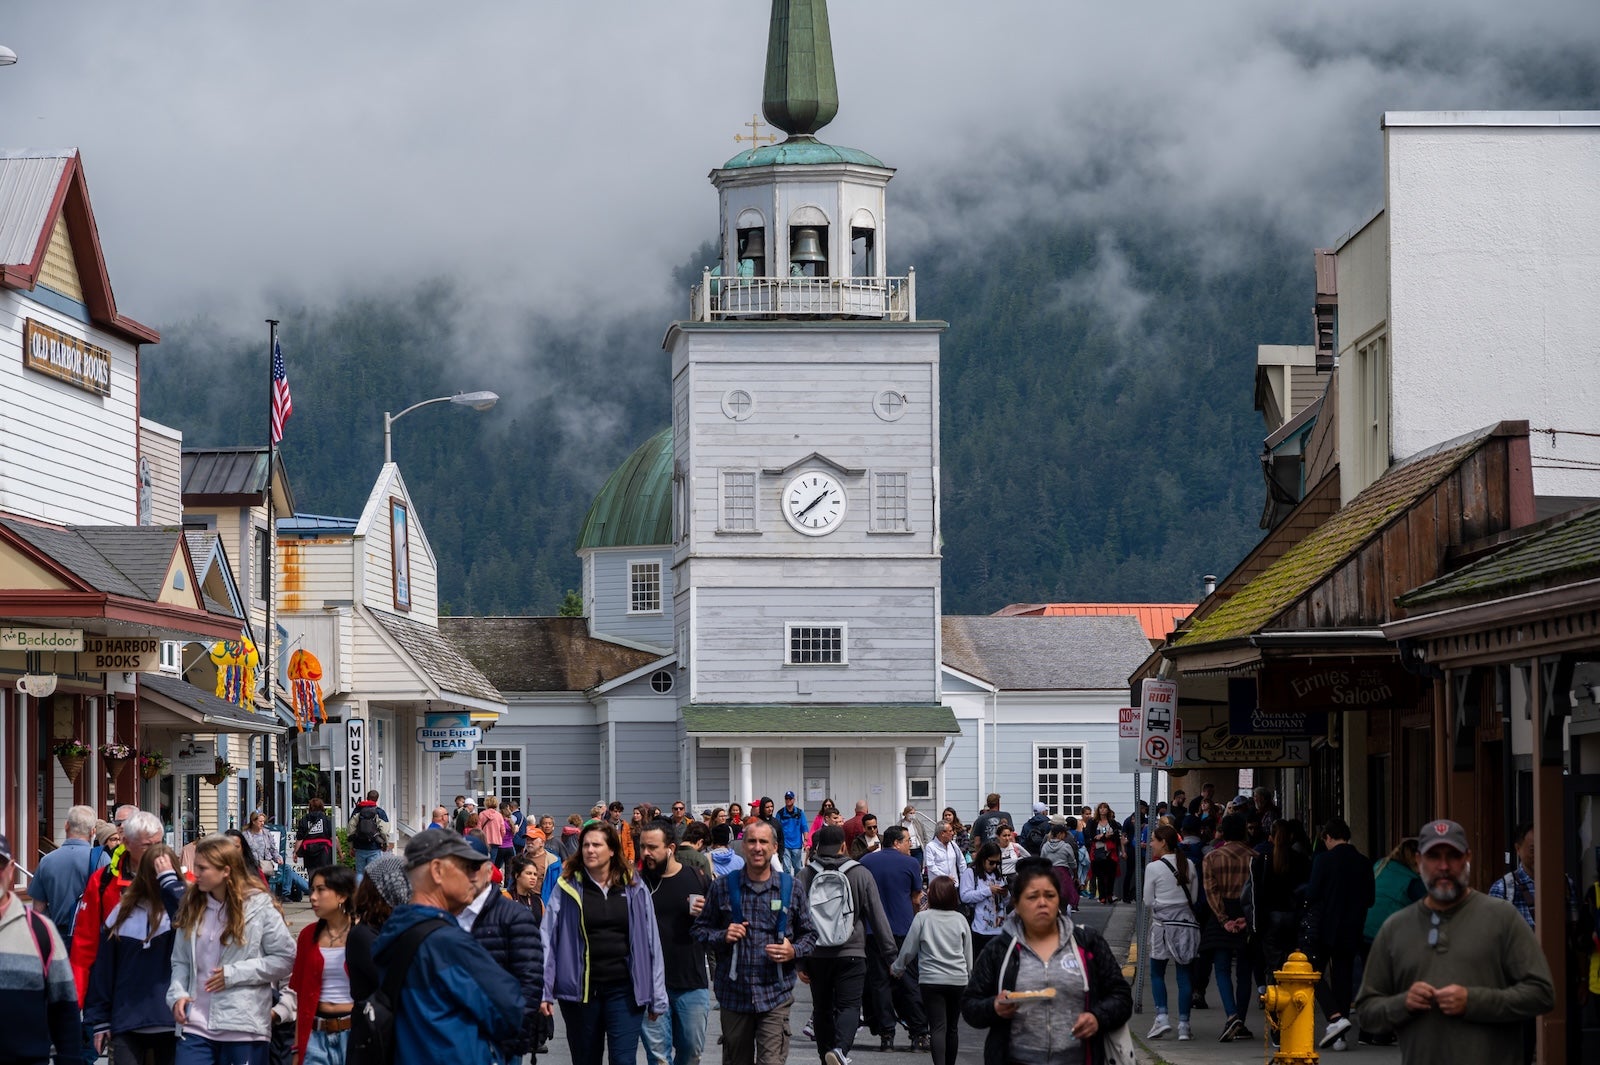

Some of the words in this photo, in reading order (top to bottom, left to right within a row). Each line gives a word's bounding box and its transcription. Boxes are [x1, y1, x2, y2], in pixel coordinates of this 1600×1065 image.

[32, 331, 48, 360] OLD
[50, 338, 82, 375] HARBOR
[83, 352, 109, 385] BOOKS
[2, 632, 17, 643] The
[18, 632, 79, 646] Backdoor
[106, 640, 157, 653] HARBOR
[96, 655, 141, 668] BOOKS
[1290, 670, 1350, 699] Ernies
[1149, 693, 1172, 703] RIDE
[1330, 685, 1393, 705] Saloon
[1120, 709, 1131, 722] NO
[1252, 718, 1305, 728] COMPANY
[422, 729, 447, 737] Blue
[449, 729, 476, 738] Eyed
[432, 739, 466, 748] BEAR
